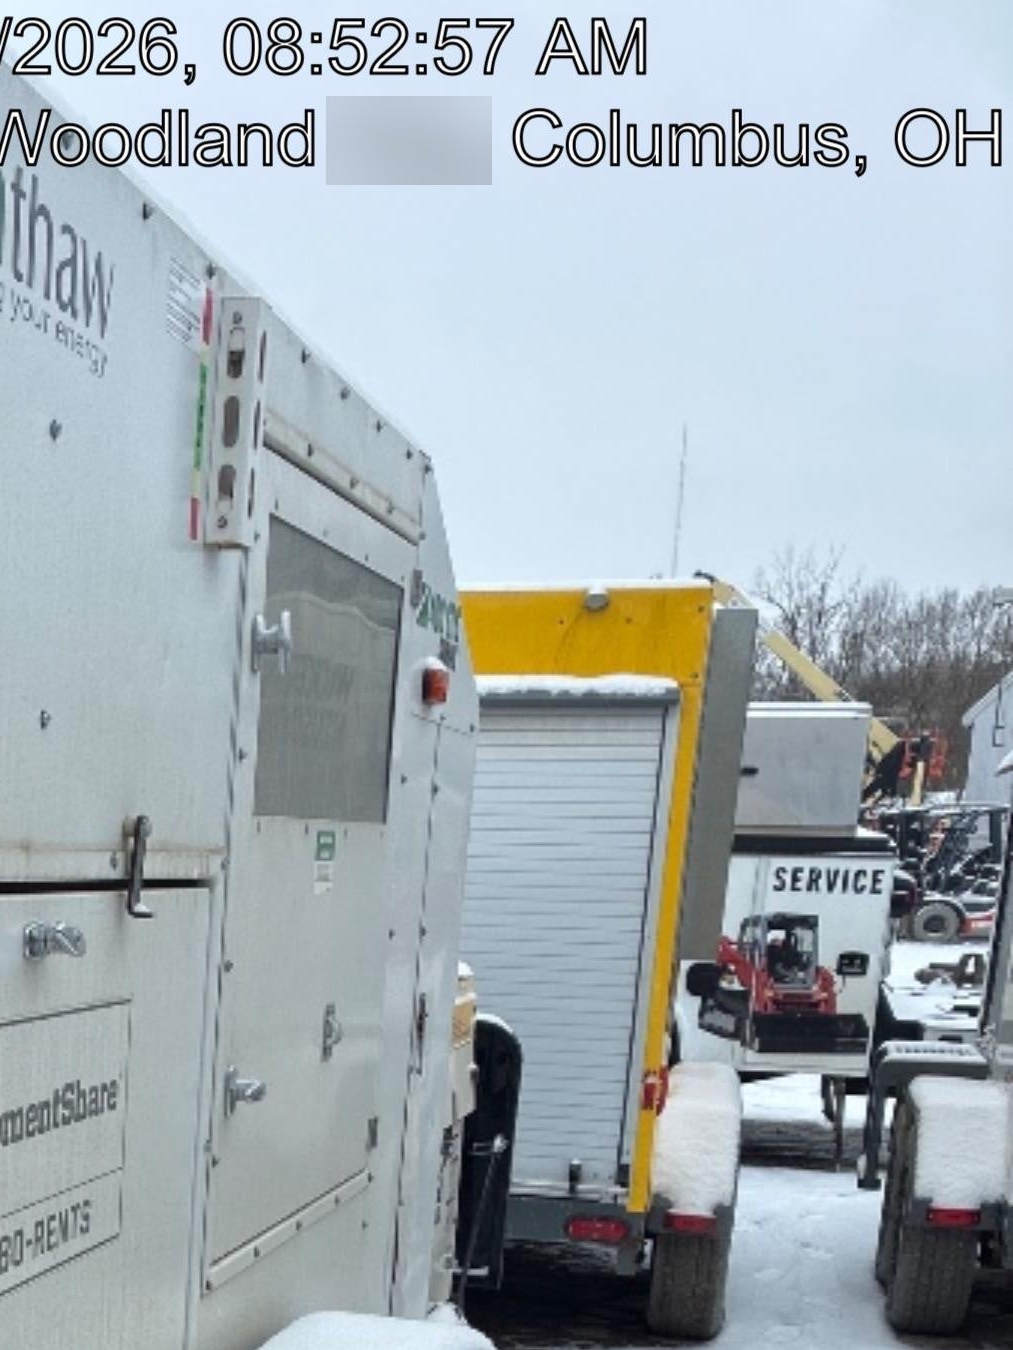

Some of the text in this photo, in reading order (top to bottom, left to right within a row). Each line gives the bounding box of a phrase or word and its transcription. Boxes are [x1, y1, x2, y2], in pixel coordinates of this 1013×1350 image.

[9, 287, 51, 334] your
[55, 320, 108, 378] energy
[772, 865, 886, 896] SERVICE
